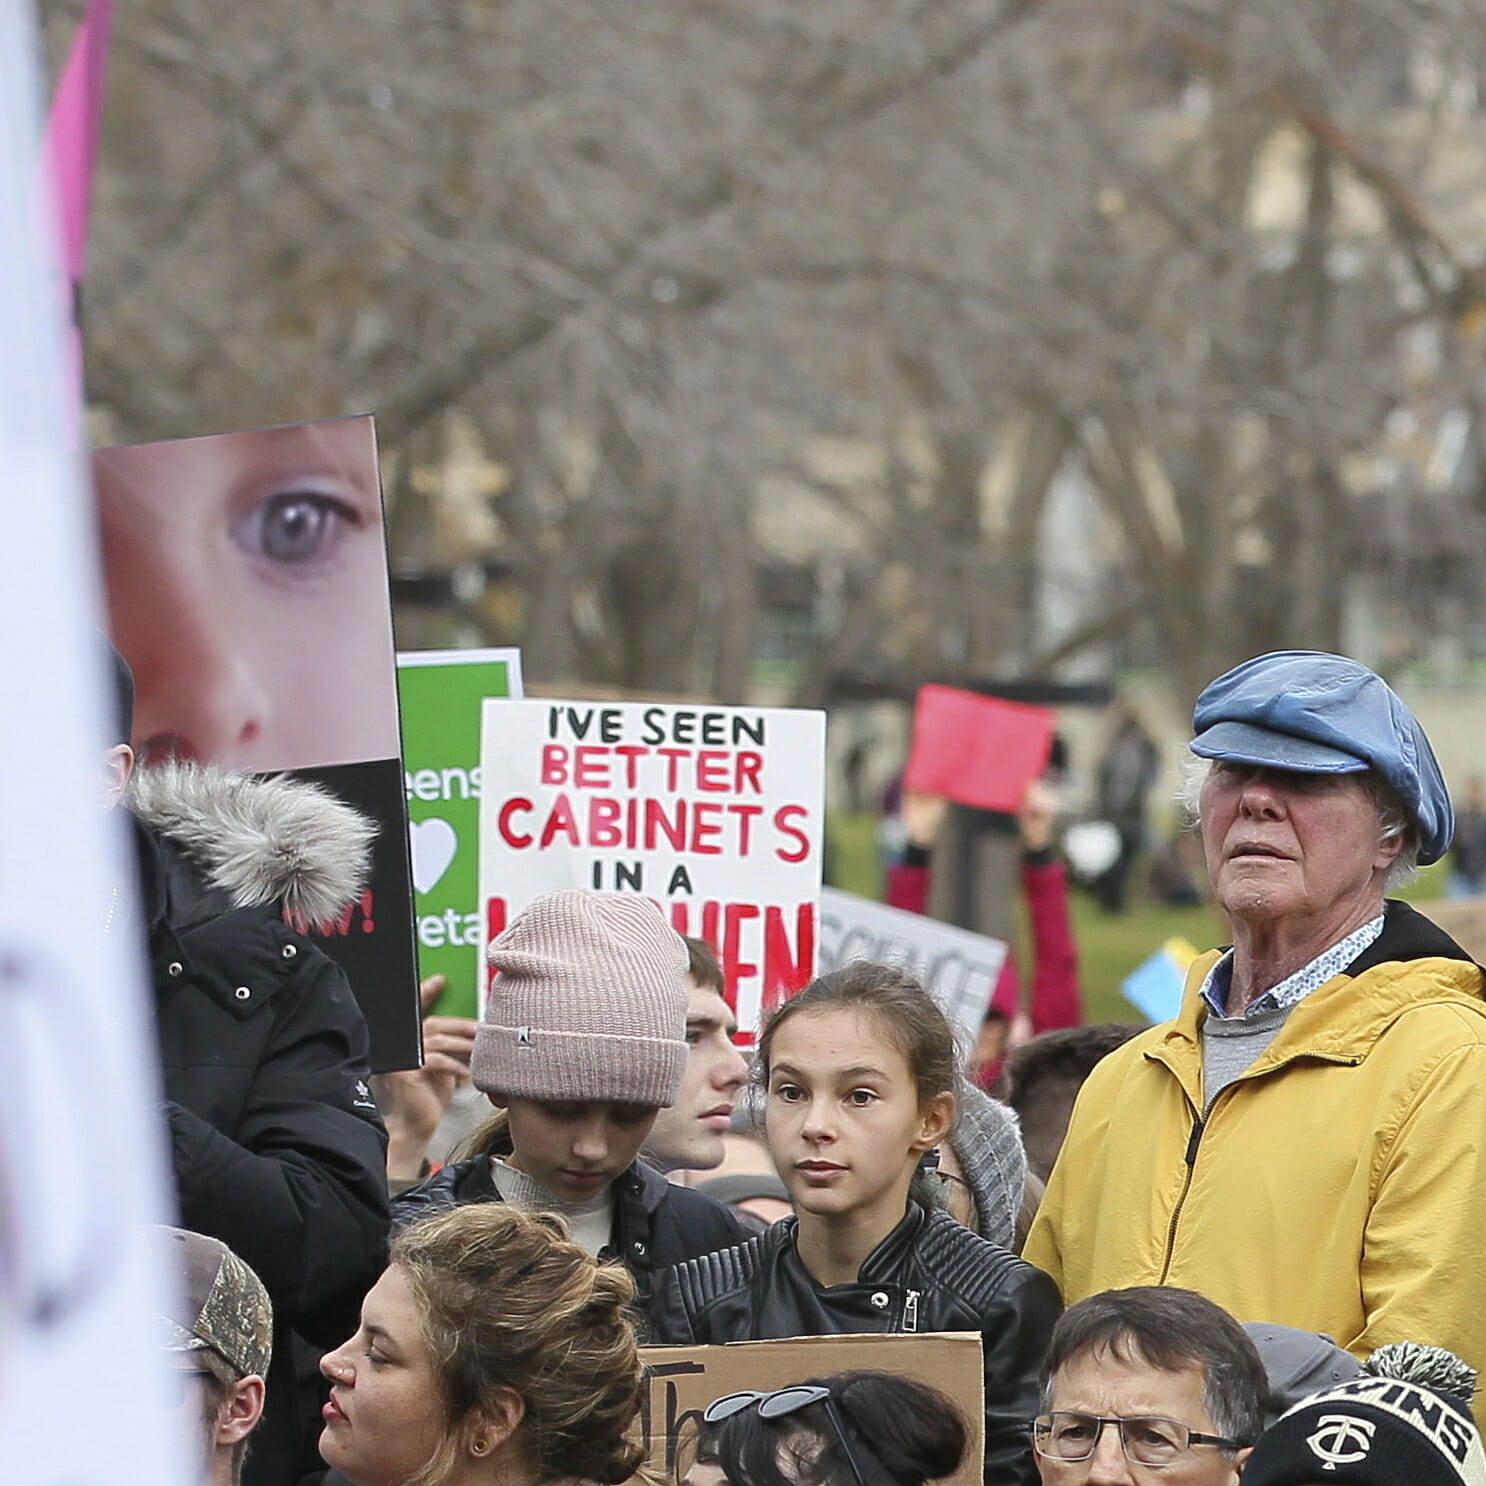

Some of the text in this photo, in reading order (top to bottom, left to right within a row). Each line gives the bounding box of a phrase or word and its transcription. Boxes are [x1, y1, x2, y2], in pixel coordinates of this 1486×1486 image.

[548, 706, 767, 747] I'VE SEEN
[540, 744, 765, 795] BETTER
[497, 793, 811, 863] CABINETS
[592, 860, 693, 896] IN A
